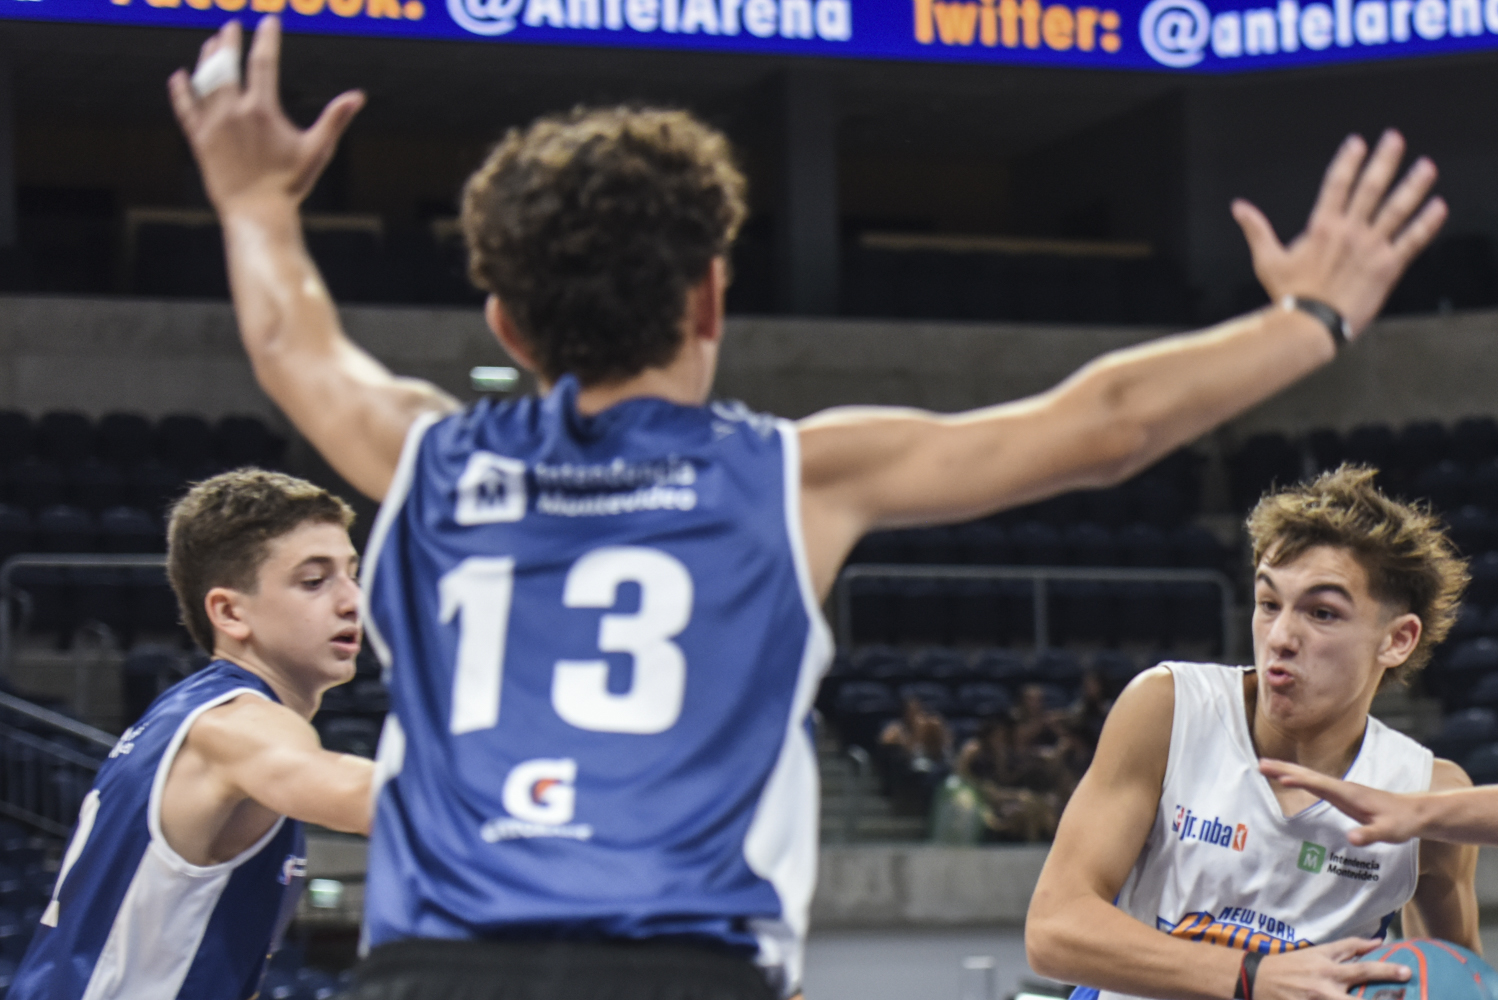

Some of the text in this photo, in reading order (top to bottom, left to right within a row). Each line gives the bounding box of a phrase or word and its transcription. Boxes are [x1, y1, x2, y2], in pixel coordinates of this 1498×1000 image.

[438, 545, 694, 735] 13
[502, 757, 577, 826] G
[1326, 864, 1380, 882] Montevideo
[1329, 851, 1380, 871] Intendencia
[1217, 906, 1256, 925] NEW
[1258, 913, 1296, 941] YORK
